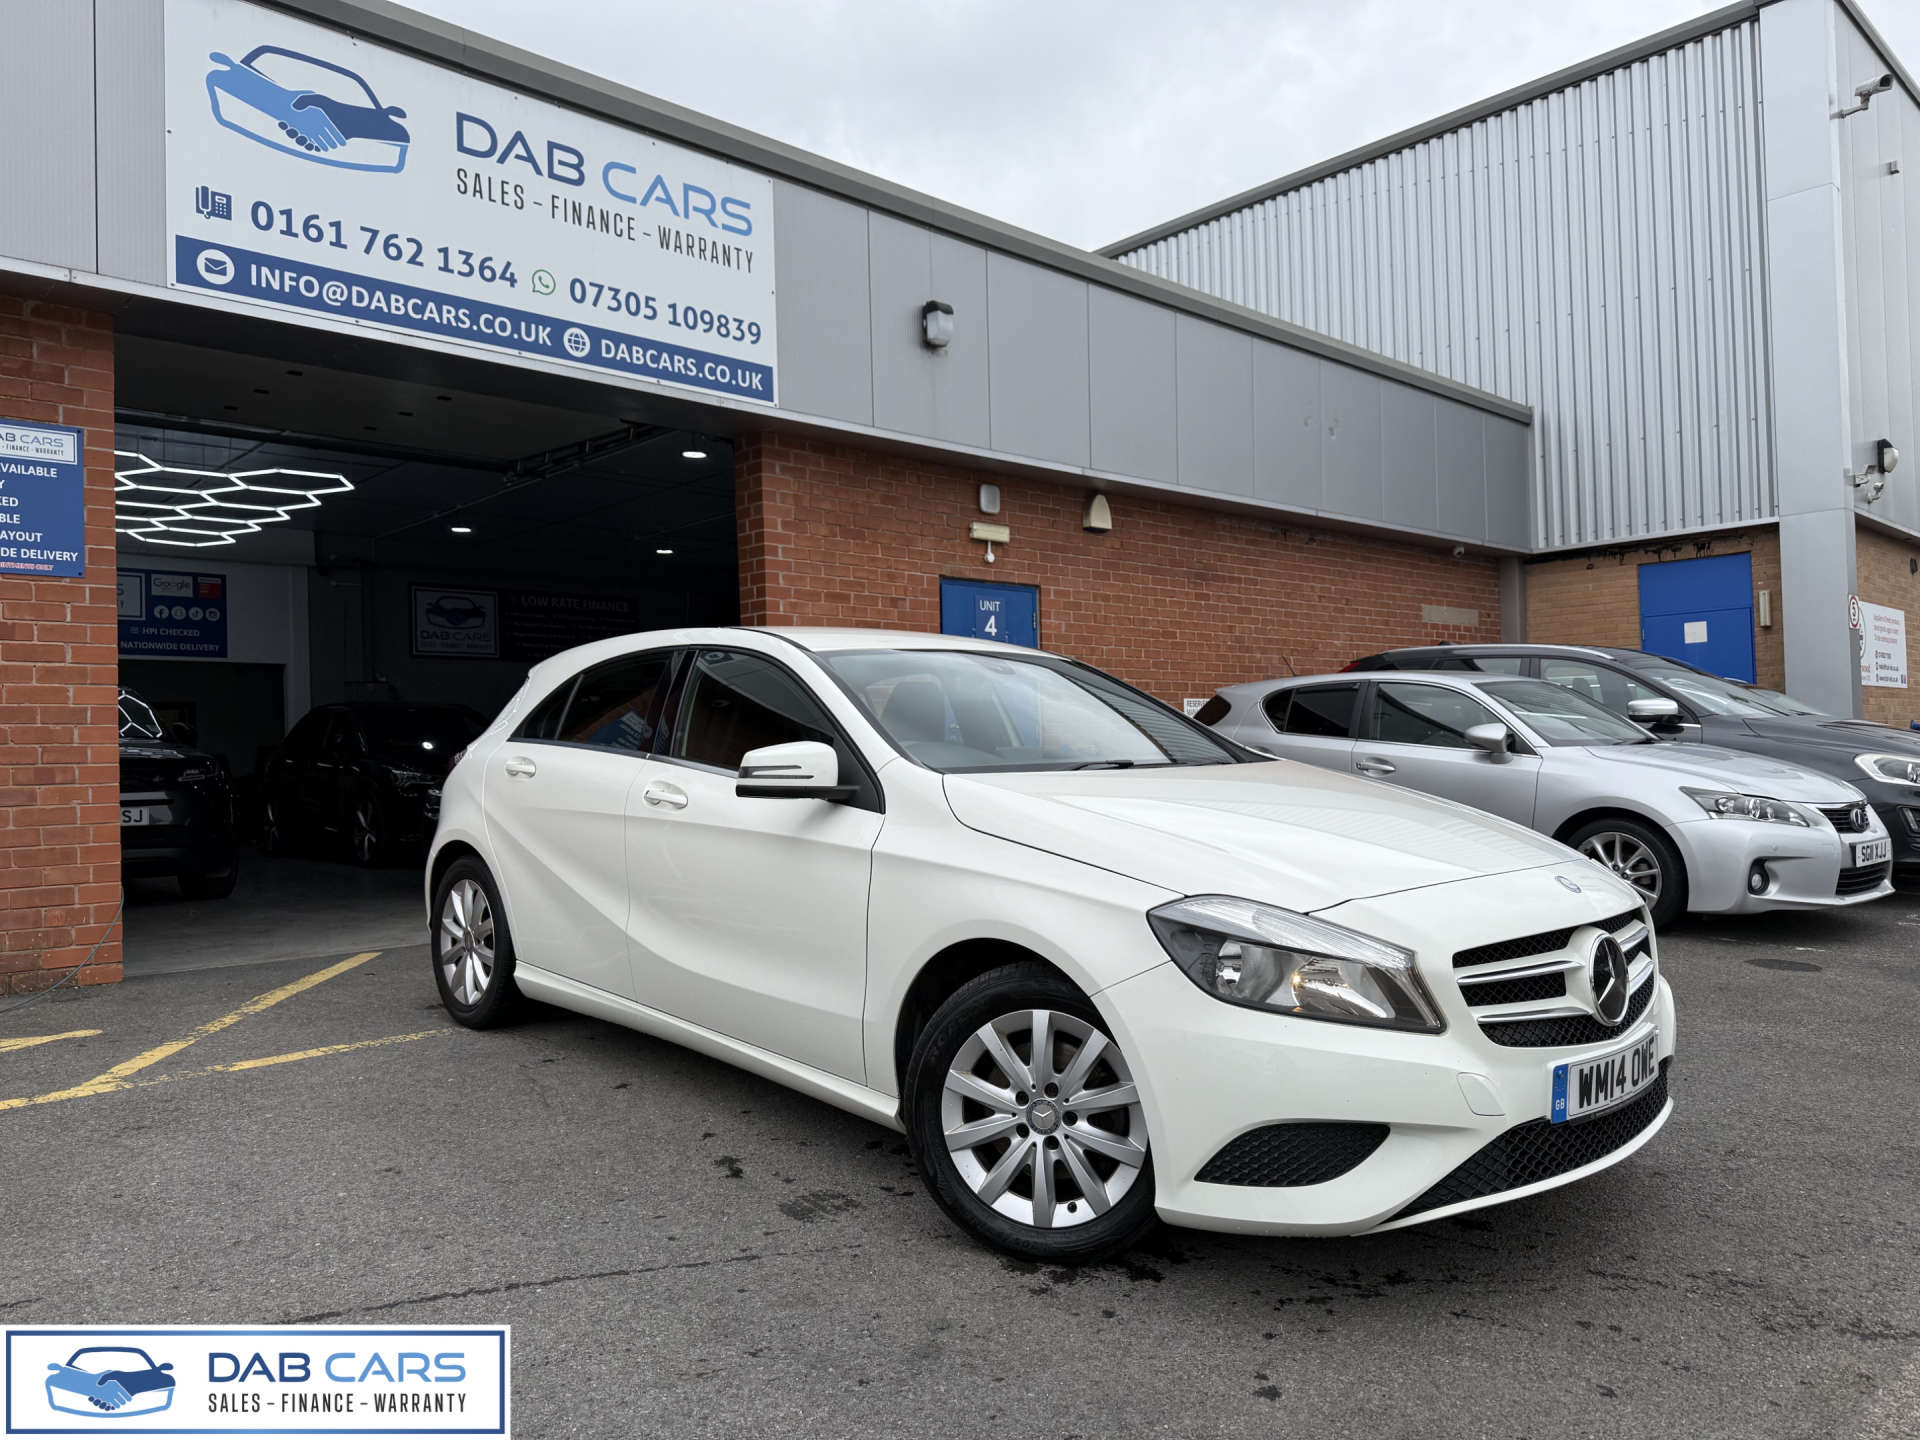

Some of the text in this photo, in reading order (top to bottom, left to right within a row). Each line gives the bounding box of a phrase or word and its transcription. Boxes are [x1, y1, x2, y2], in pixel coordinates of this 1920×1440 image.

[456, 111, 752, 236] DAB CARS
[457, 168, 524, 210] SALES
[551, 194, 636, 241] FINANCE
[657, 225, 753, 273] WARRANTY
[251, 200, 518, 288] 0161 762 1364
[250, 263, 552, 346] INFO@DABCARS.CO.UK
[569, 278, 761, 345] 07305 109839
[601, 339, 764, 391] DABCARS.CO.UK
[6, 443, 29, 452] FINANCE
[20, 434, 64, 447] CARS
[0, 464, 57, 478] VAILABLE
[1, 547, 78, 562] DE DELIVERY
[521, 595, 629, 612] LOW RATE FINANCE
[979, 600, 1000, 611] UNIT
[159, 627, 200, 636] CHECKED
[984, 615, 997, 636] 4
[420, 630, 451, 641] DAB
[120, 641, 220, 652] NATIONWIDE DELIVERY
[121, 809, 143, 823] SJ
[1579, 1036, 1655, 1109] WM14 ONE
[1555, 1098, 1565, 1111] GB
